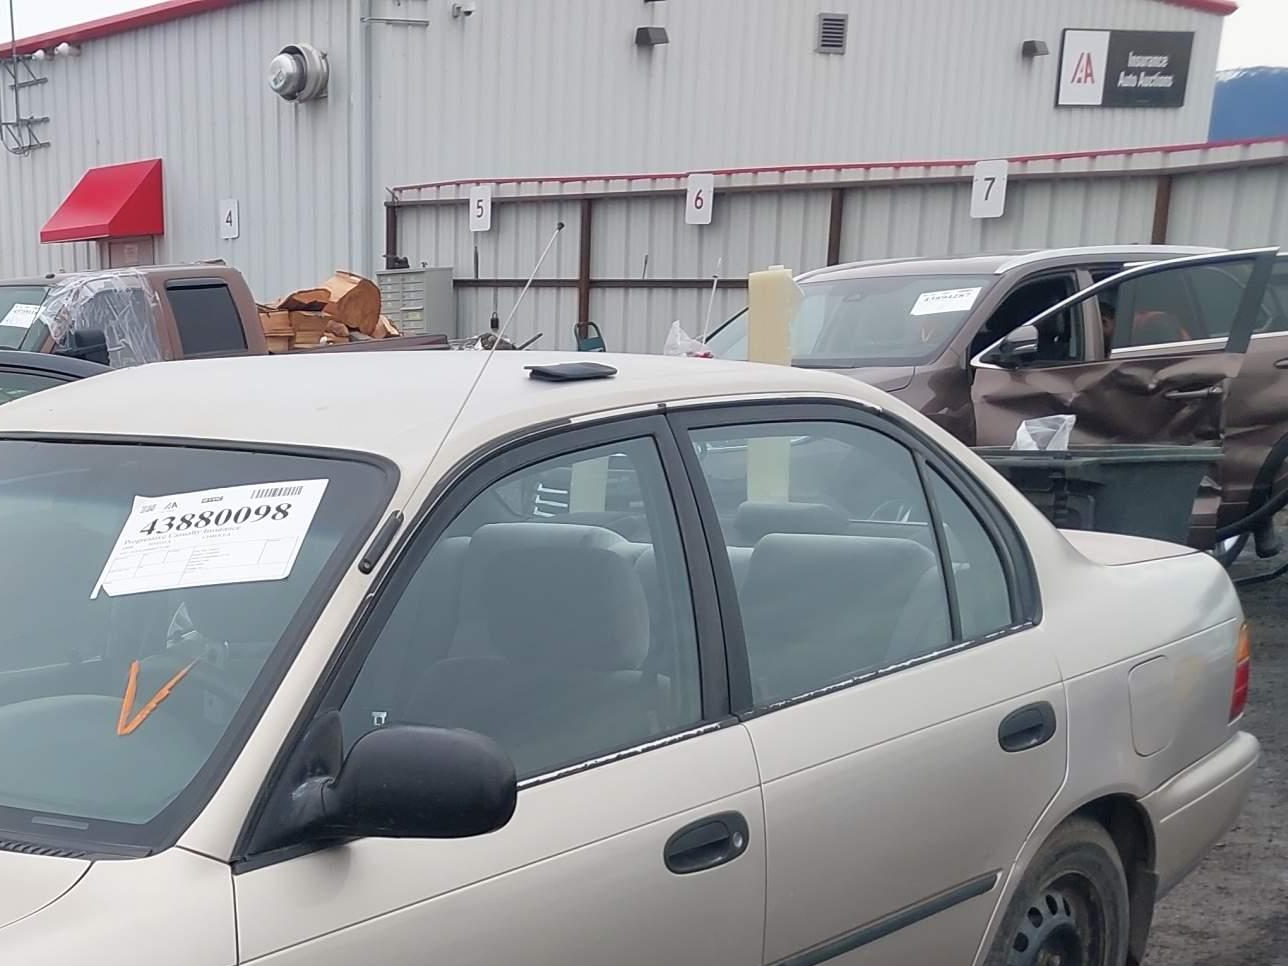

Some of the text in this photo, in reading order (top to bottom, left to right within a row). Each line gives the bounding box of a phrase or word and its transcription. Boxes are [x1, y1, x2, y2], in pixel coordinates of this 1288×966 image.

[1127, 50, 1169, 68] Insurance
[1117, 71, 1174, 88] Auto Auctions
[983, 177, 996, 201] 7
[476, 199, 484, 218] 5
[694, 189, 704, 210] 6
[225, 209, 233, 227] 4
[139, 502, 293, 536] 43880098
